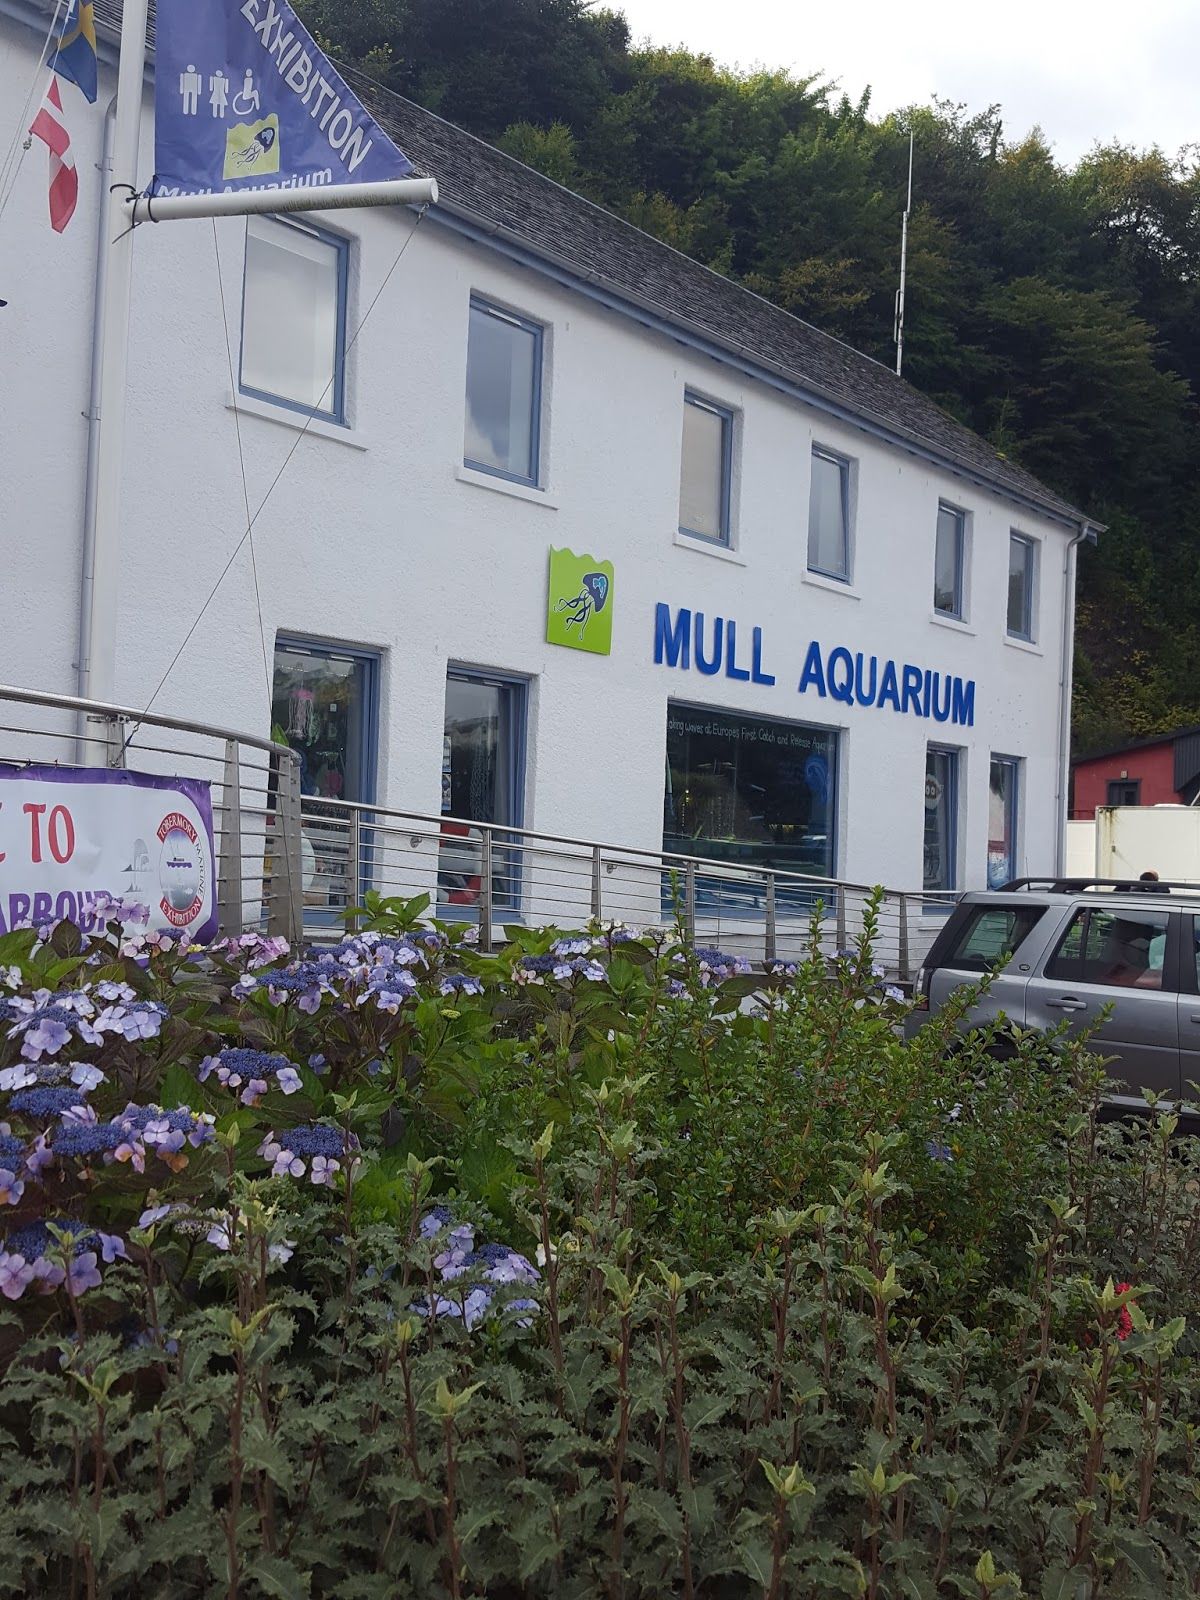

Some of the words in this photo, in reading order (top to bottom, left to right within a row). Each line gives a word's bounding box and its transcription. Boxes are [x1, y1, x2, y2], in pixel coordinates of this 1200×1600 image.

[240, 0, 373, 173] EXHIBITION
[654, 602, 775, 686] MULL
[798, 641, 975, 727] AQUARIUM
[667, 717, 684, 737] aking
[685, 722, 704, 735] waves
[704, 722, 712, 735] at
[712, 723, 739, 741] Europes
[741, 727, 757, 741] First
[758, 728, 776, 743] Catch
[777, 731, 788, 744] and
[791, 734, 811, 749] Release
[22, 803, 75, 864] TO
[158, 815, 198, 840] TOBERMORY
[195, 842, 205, 897] MARINE
[162, 901, 202, 925] EXHIBITION
